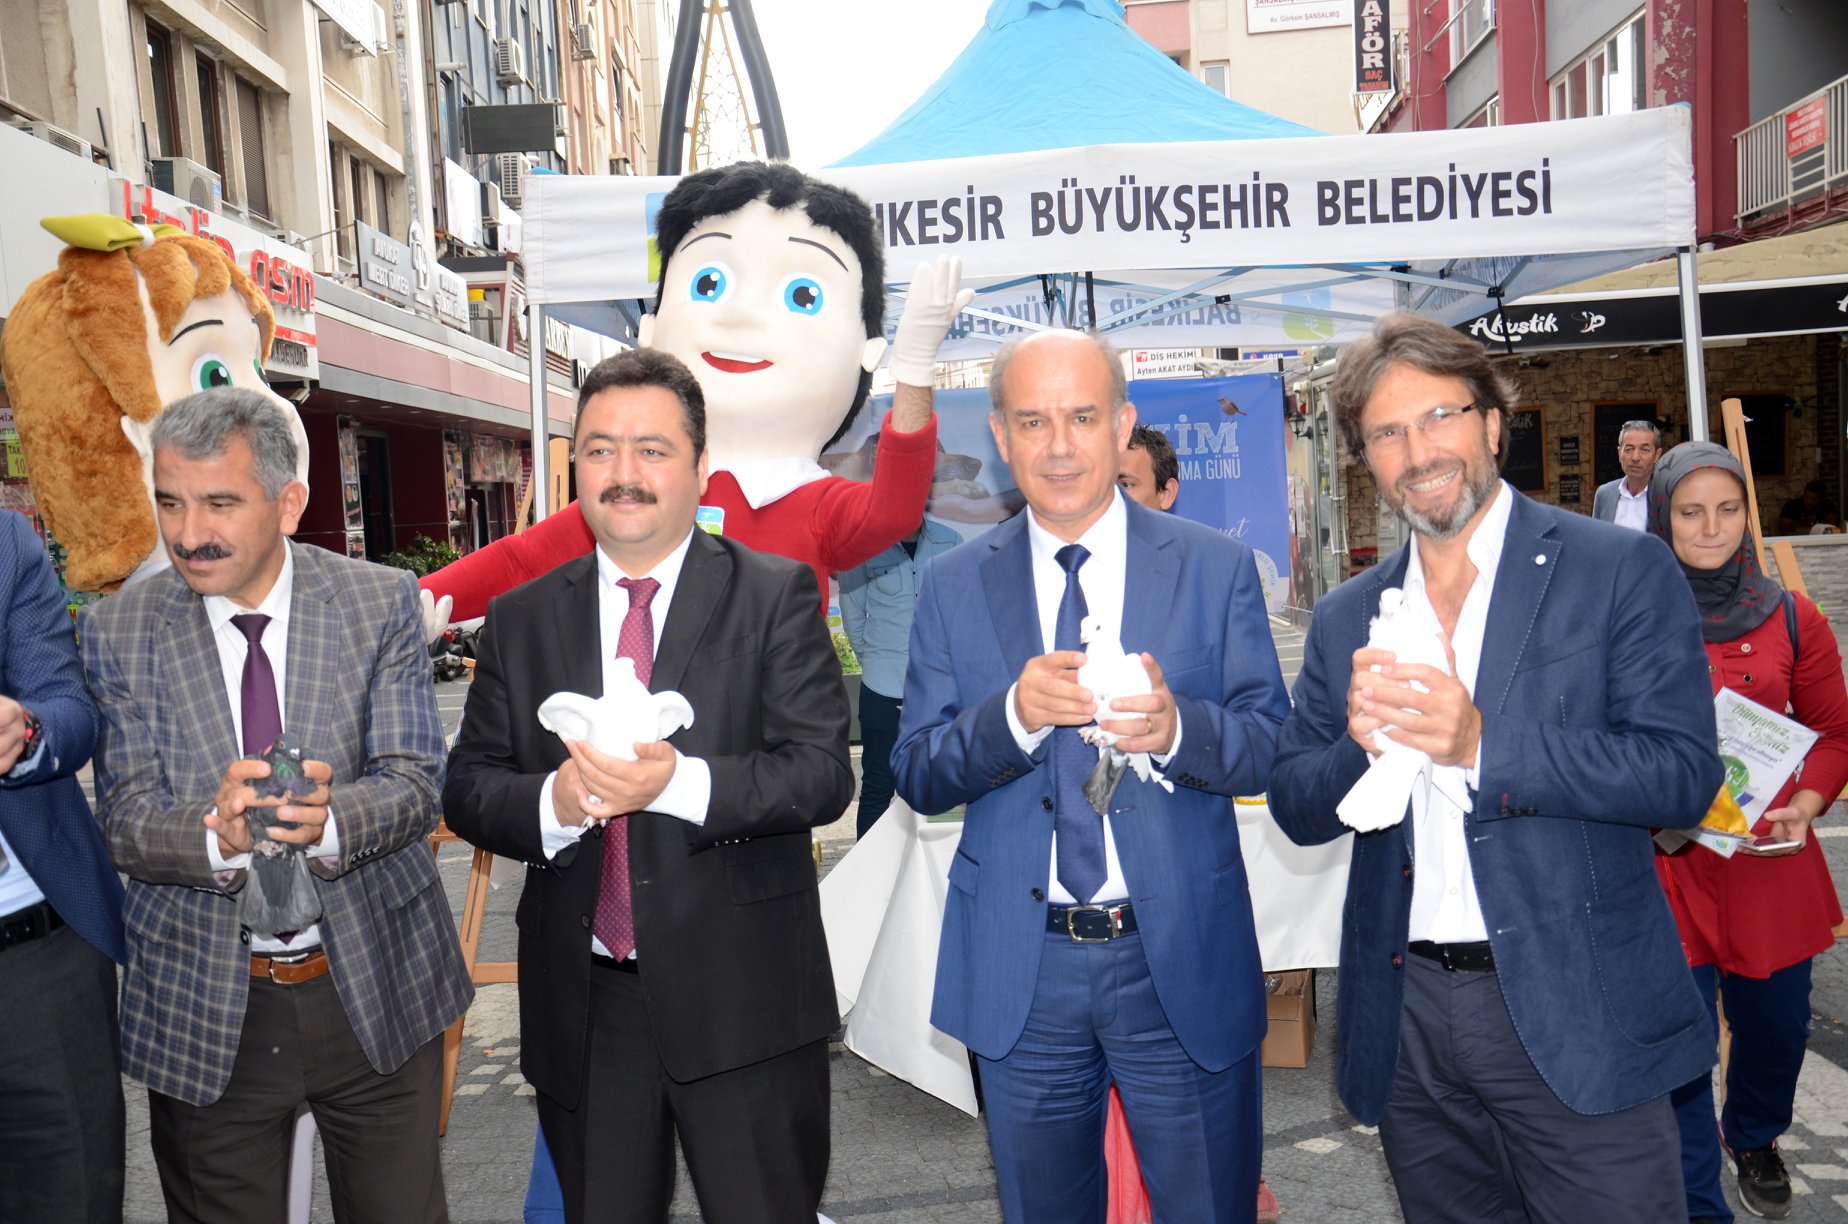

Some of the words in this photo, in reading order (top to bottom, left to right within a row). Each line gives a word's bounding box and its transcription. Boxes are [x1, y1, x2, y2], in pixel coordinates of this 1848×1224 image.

[1031, 171, 1291, 243] BÜYÜKŞEHİR
[1317, 158, 1552, 226] BELEDİYESİ
[1469, 312, 1559, 342] Akustik
[1137, 367, 1157, 376] Ayten
[1178, 363, 1194, 372] AYDI
[1150, 352, 1165, 361] DİŞ
[1206, 454, 1240, 480] GÜNÜ
